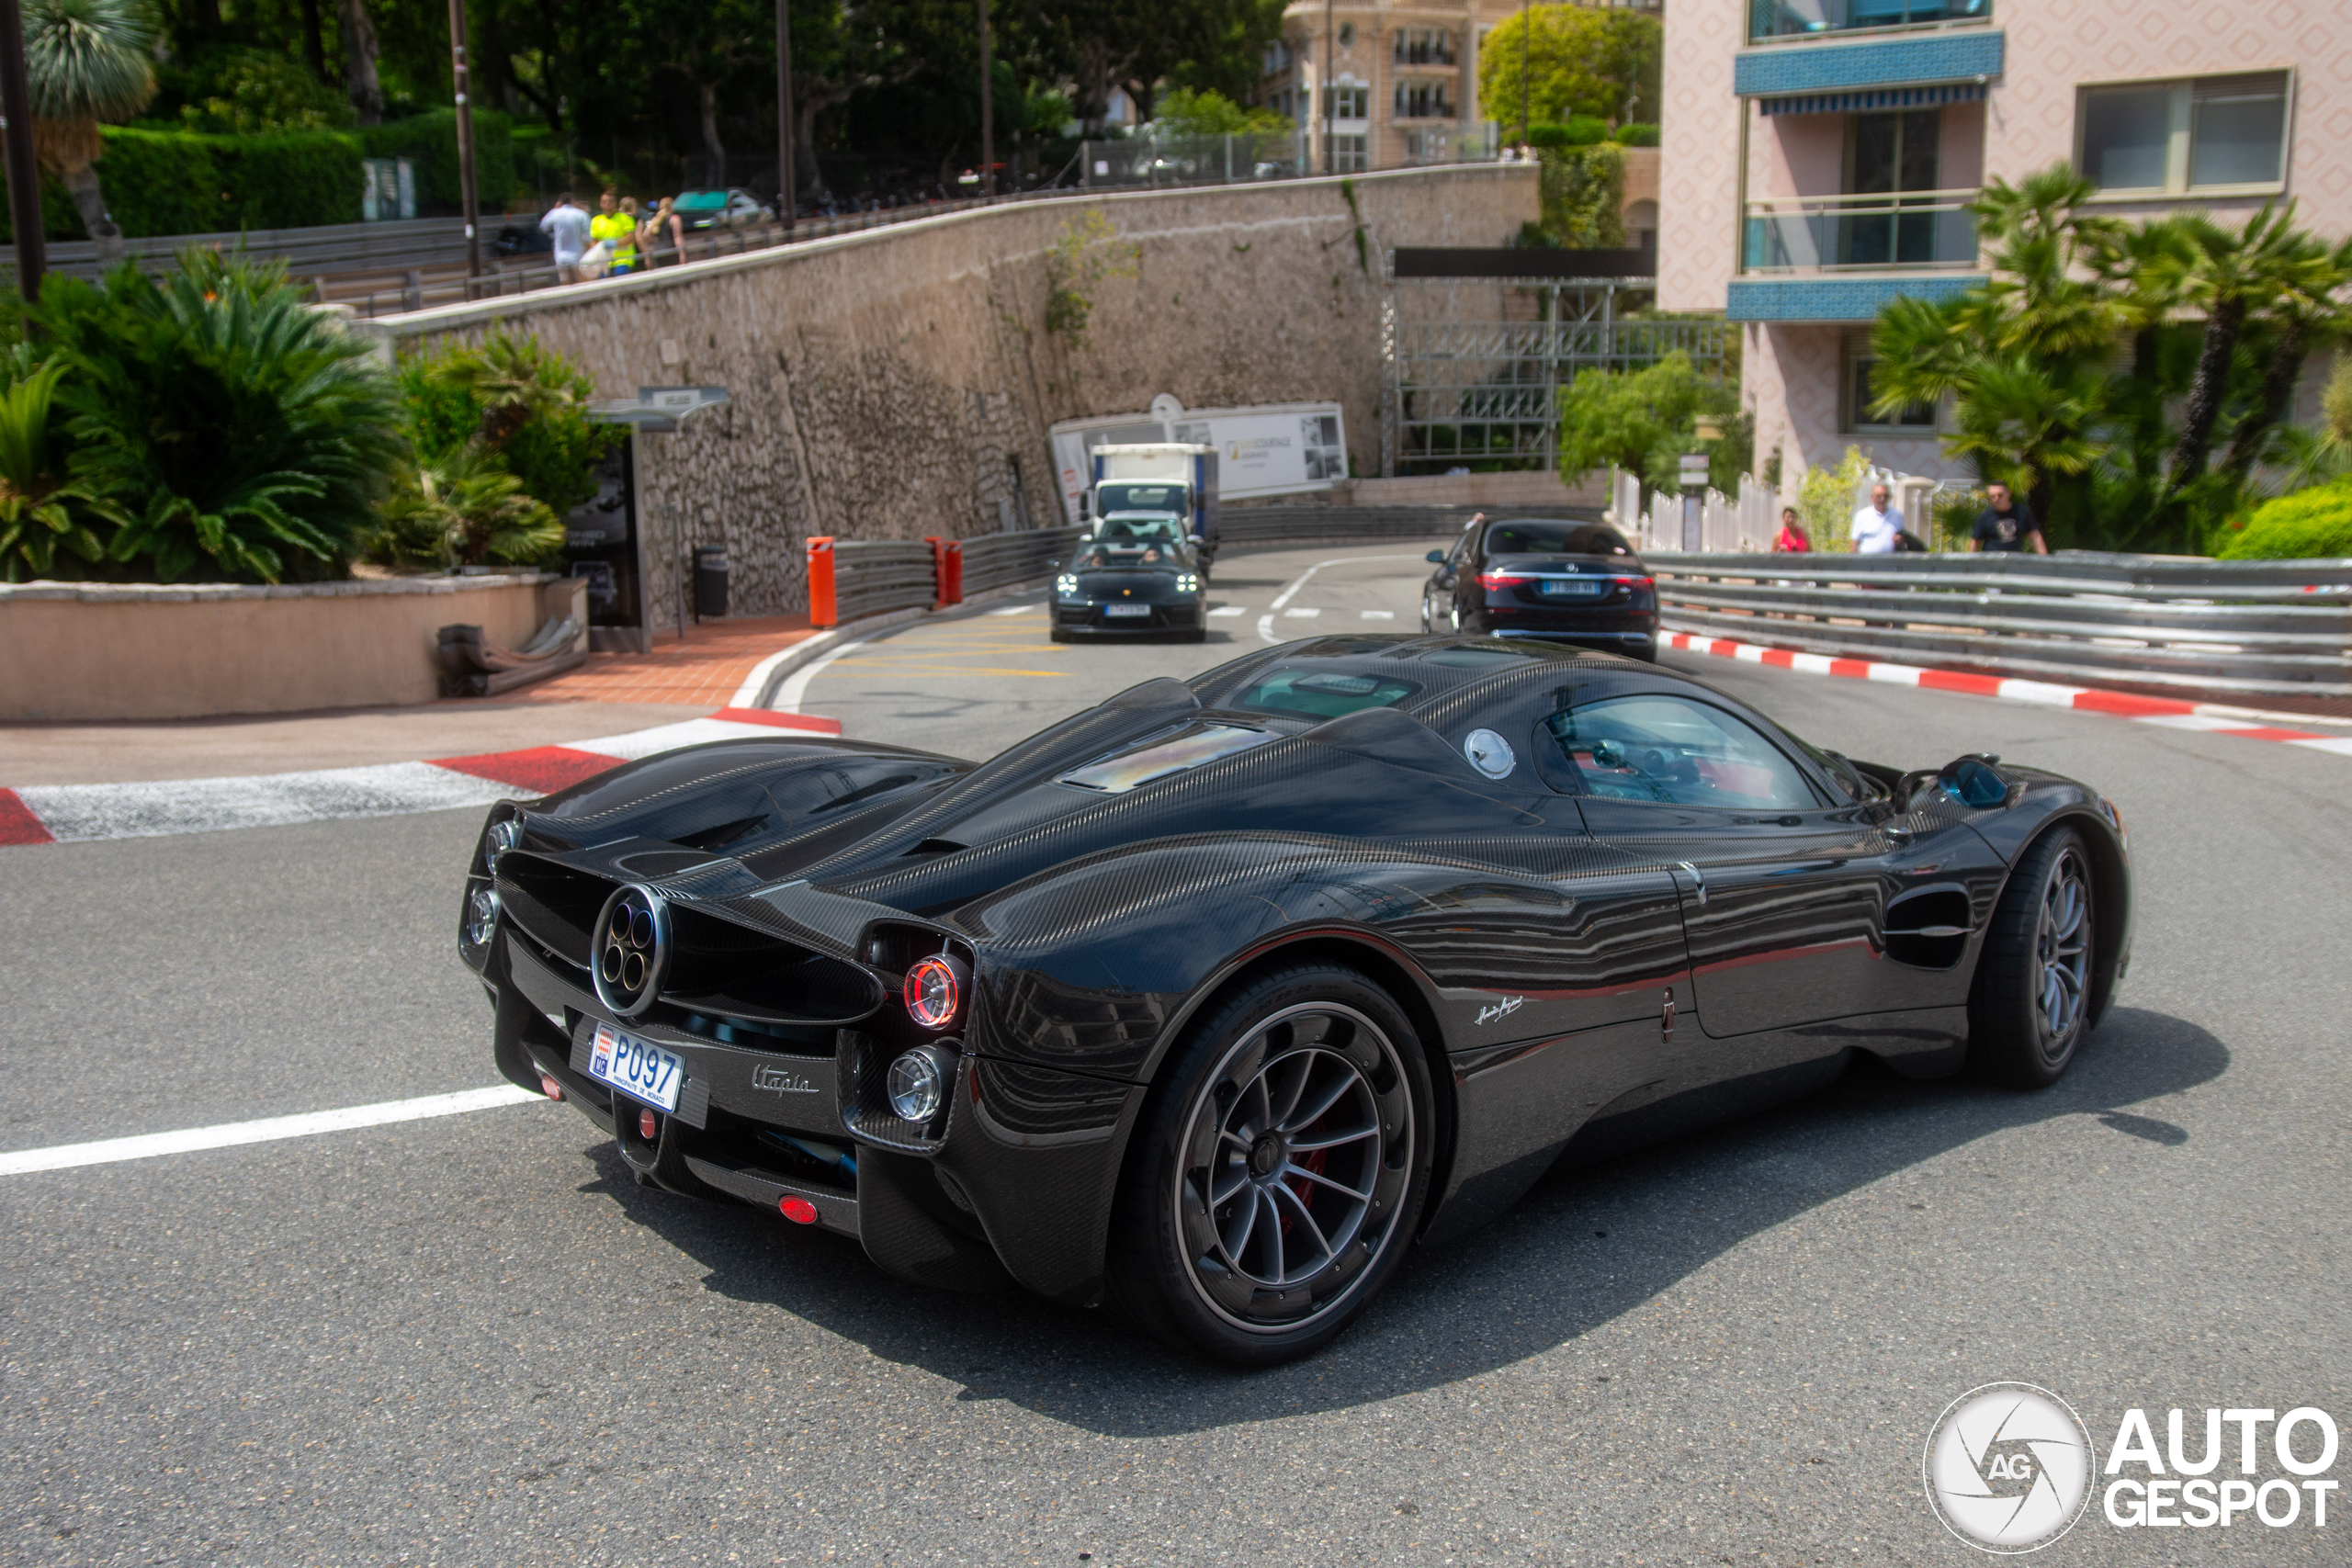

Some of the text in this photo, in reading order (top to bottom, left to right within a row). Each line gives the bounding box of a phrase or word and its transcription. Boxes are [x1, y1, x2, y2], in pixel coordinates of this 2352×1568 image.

[595, 1058, 605, 1073] MC
[613, 1034, 677, 1094] P097
[613, 1075, 665, 1104] PRINCIPAUTE DE MONACO
[752, 1064, 820, 1099] Utopia
